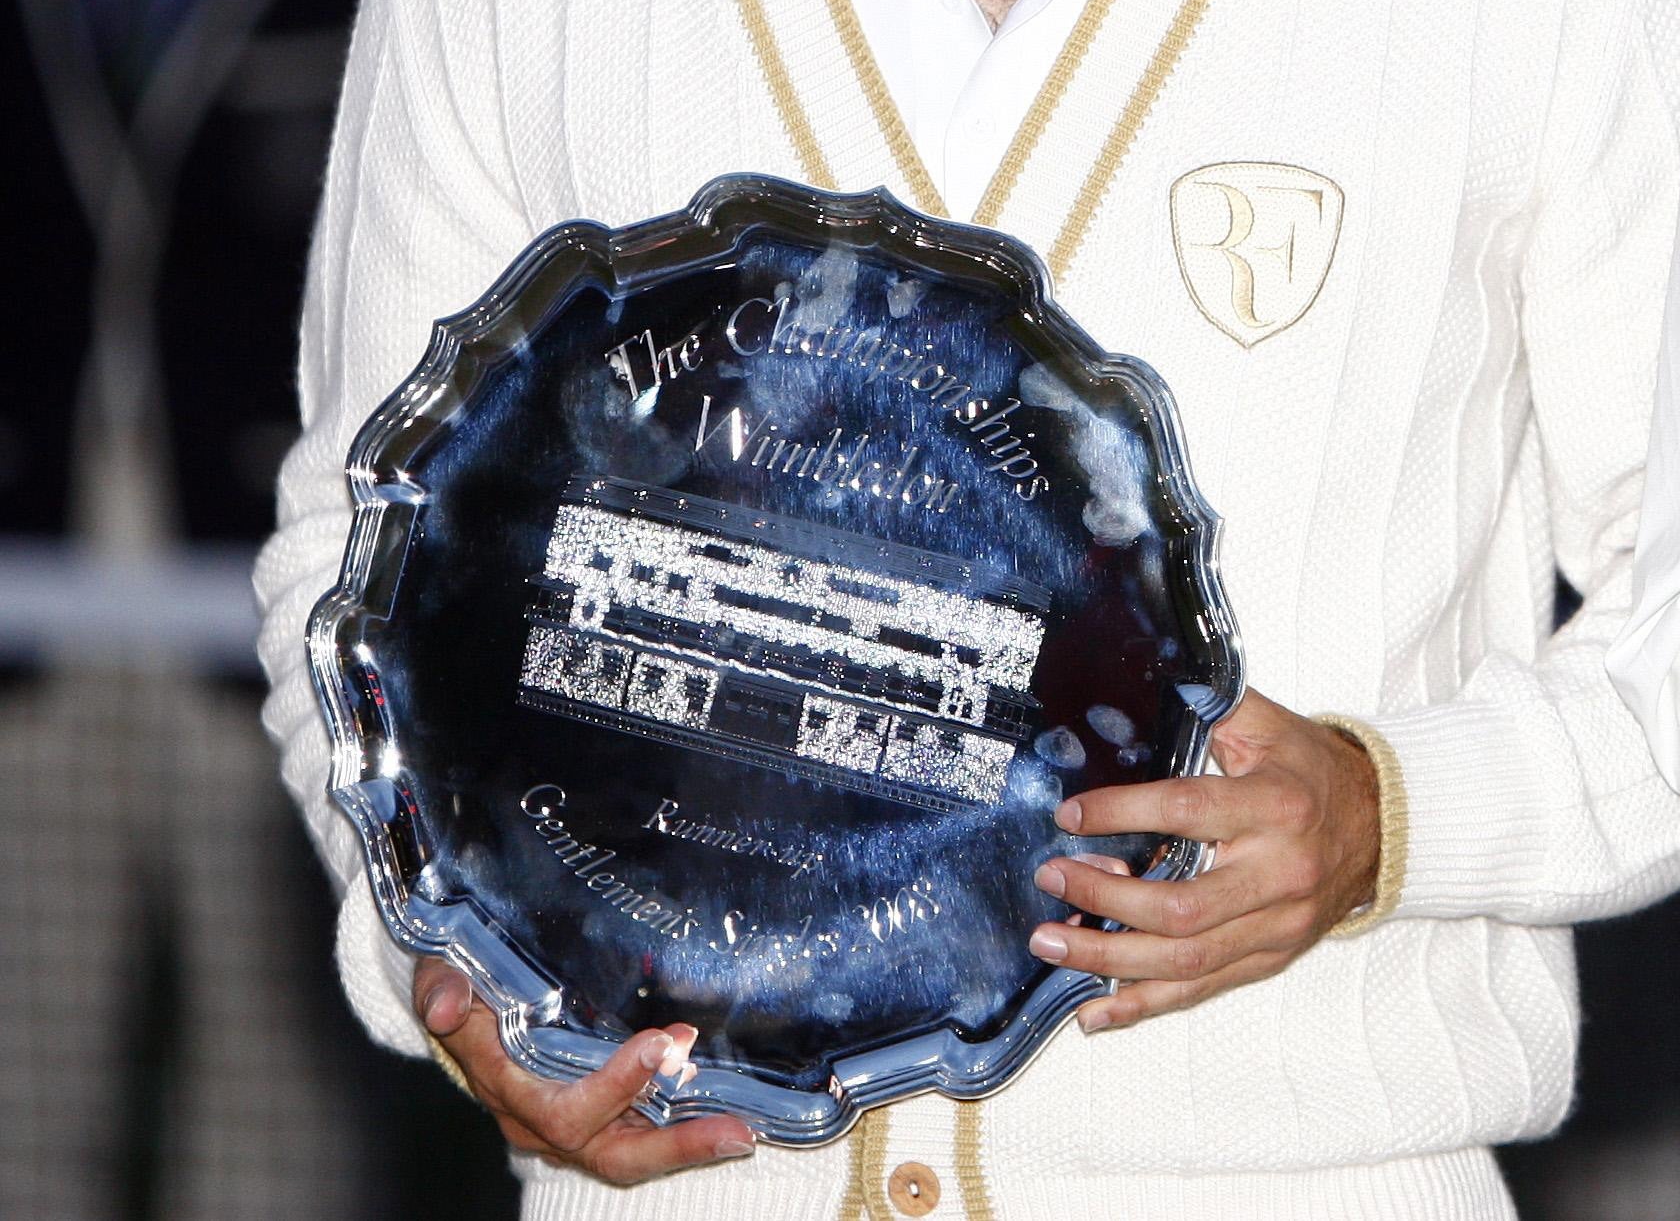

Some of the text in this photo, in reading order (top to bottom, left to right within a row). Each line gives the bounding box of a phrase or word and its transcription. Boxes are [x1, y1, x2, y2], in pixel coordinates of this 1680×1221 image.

[604, 295, 1050, 502] The Championships
[694, 394, 959, 514] Wimbledon
[851, 874, 943, 954] 2008
